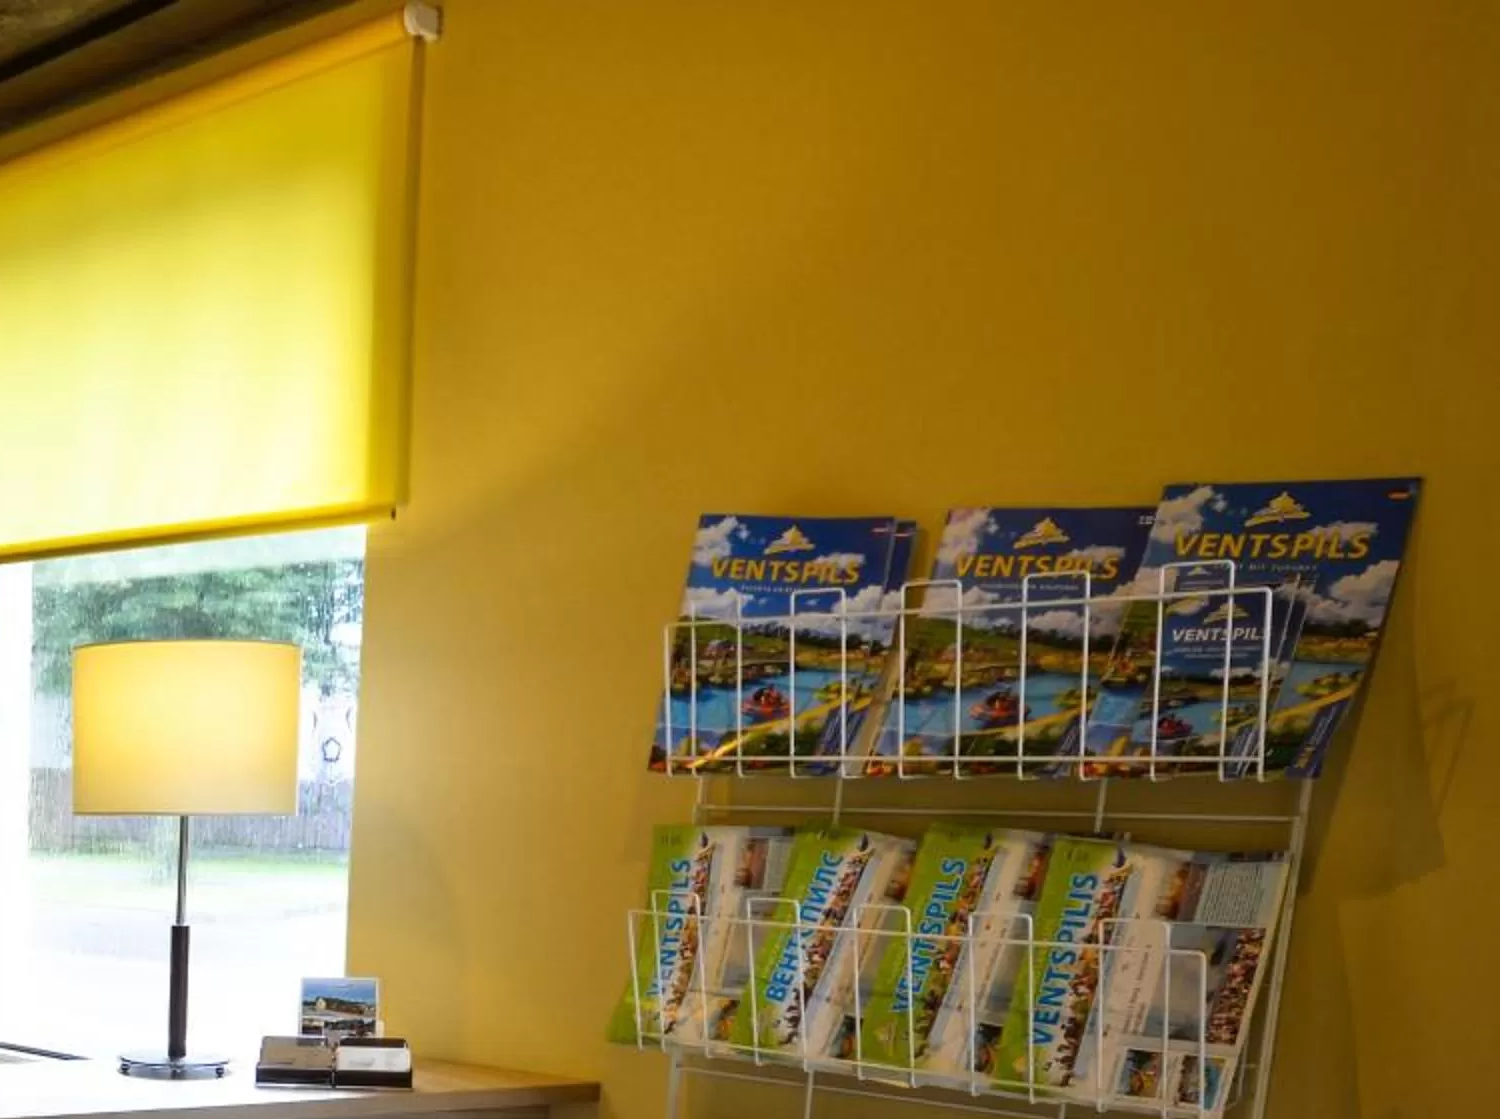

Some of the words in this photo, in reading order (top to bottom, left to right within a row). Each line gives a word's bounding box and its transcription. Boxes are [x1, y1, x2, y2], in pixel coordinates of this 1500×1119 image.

[1175, 528, 1370, 560] VENTSPILS
[711, 556, 861, 585] VENTSPILS
[956, 554, 1119, 581] VENTSPILS
[1172, 627, 1267, 643] VENTSPIL
[645, 858, 691, 997] VENTSPLS
